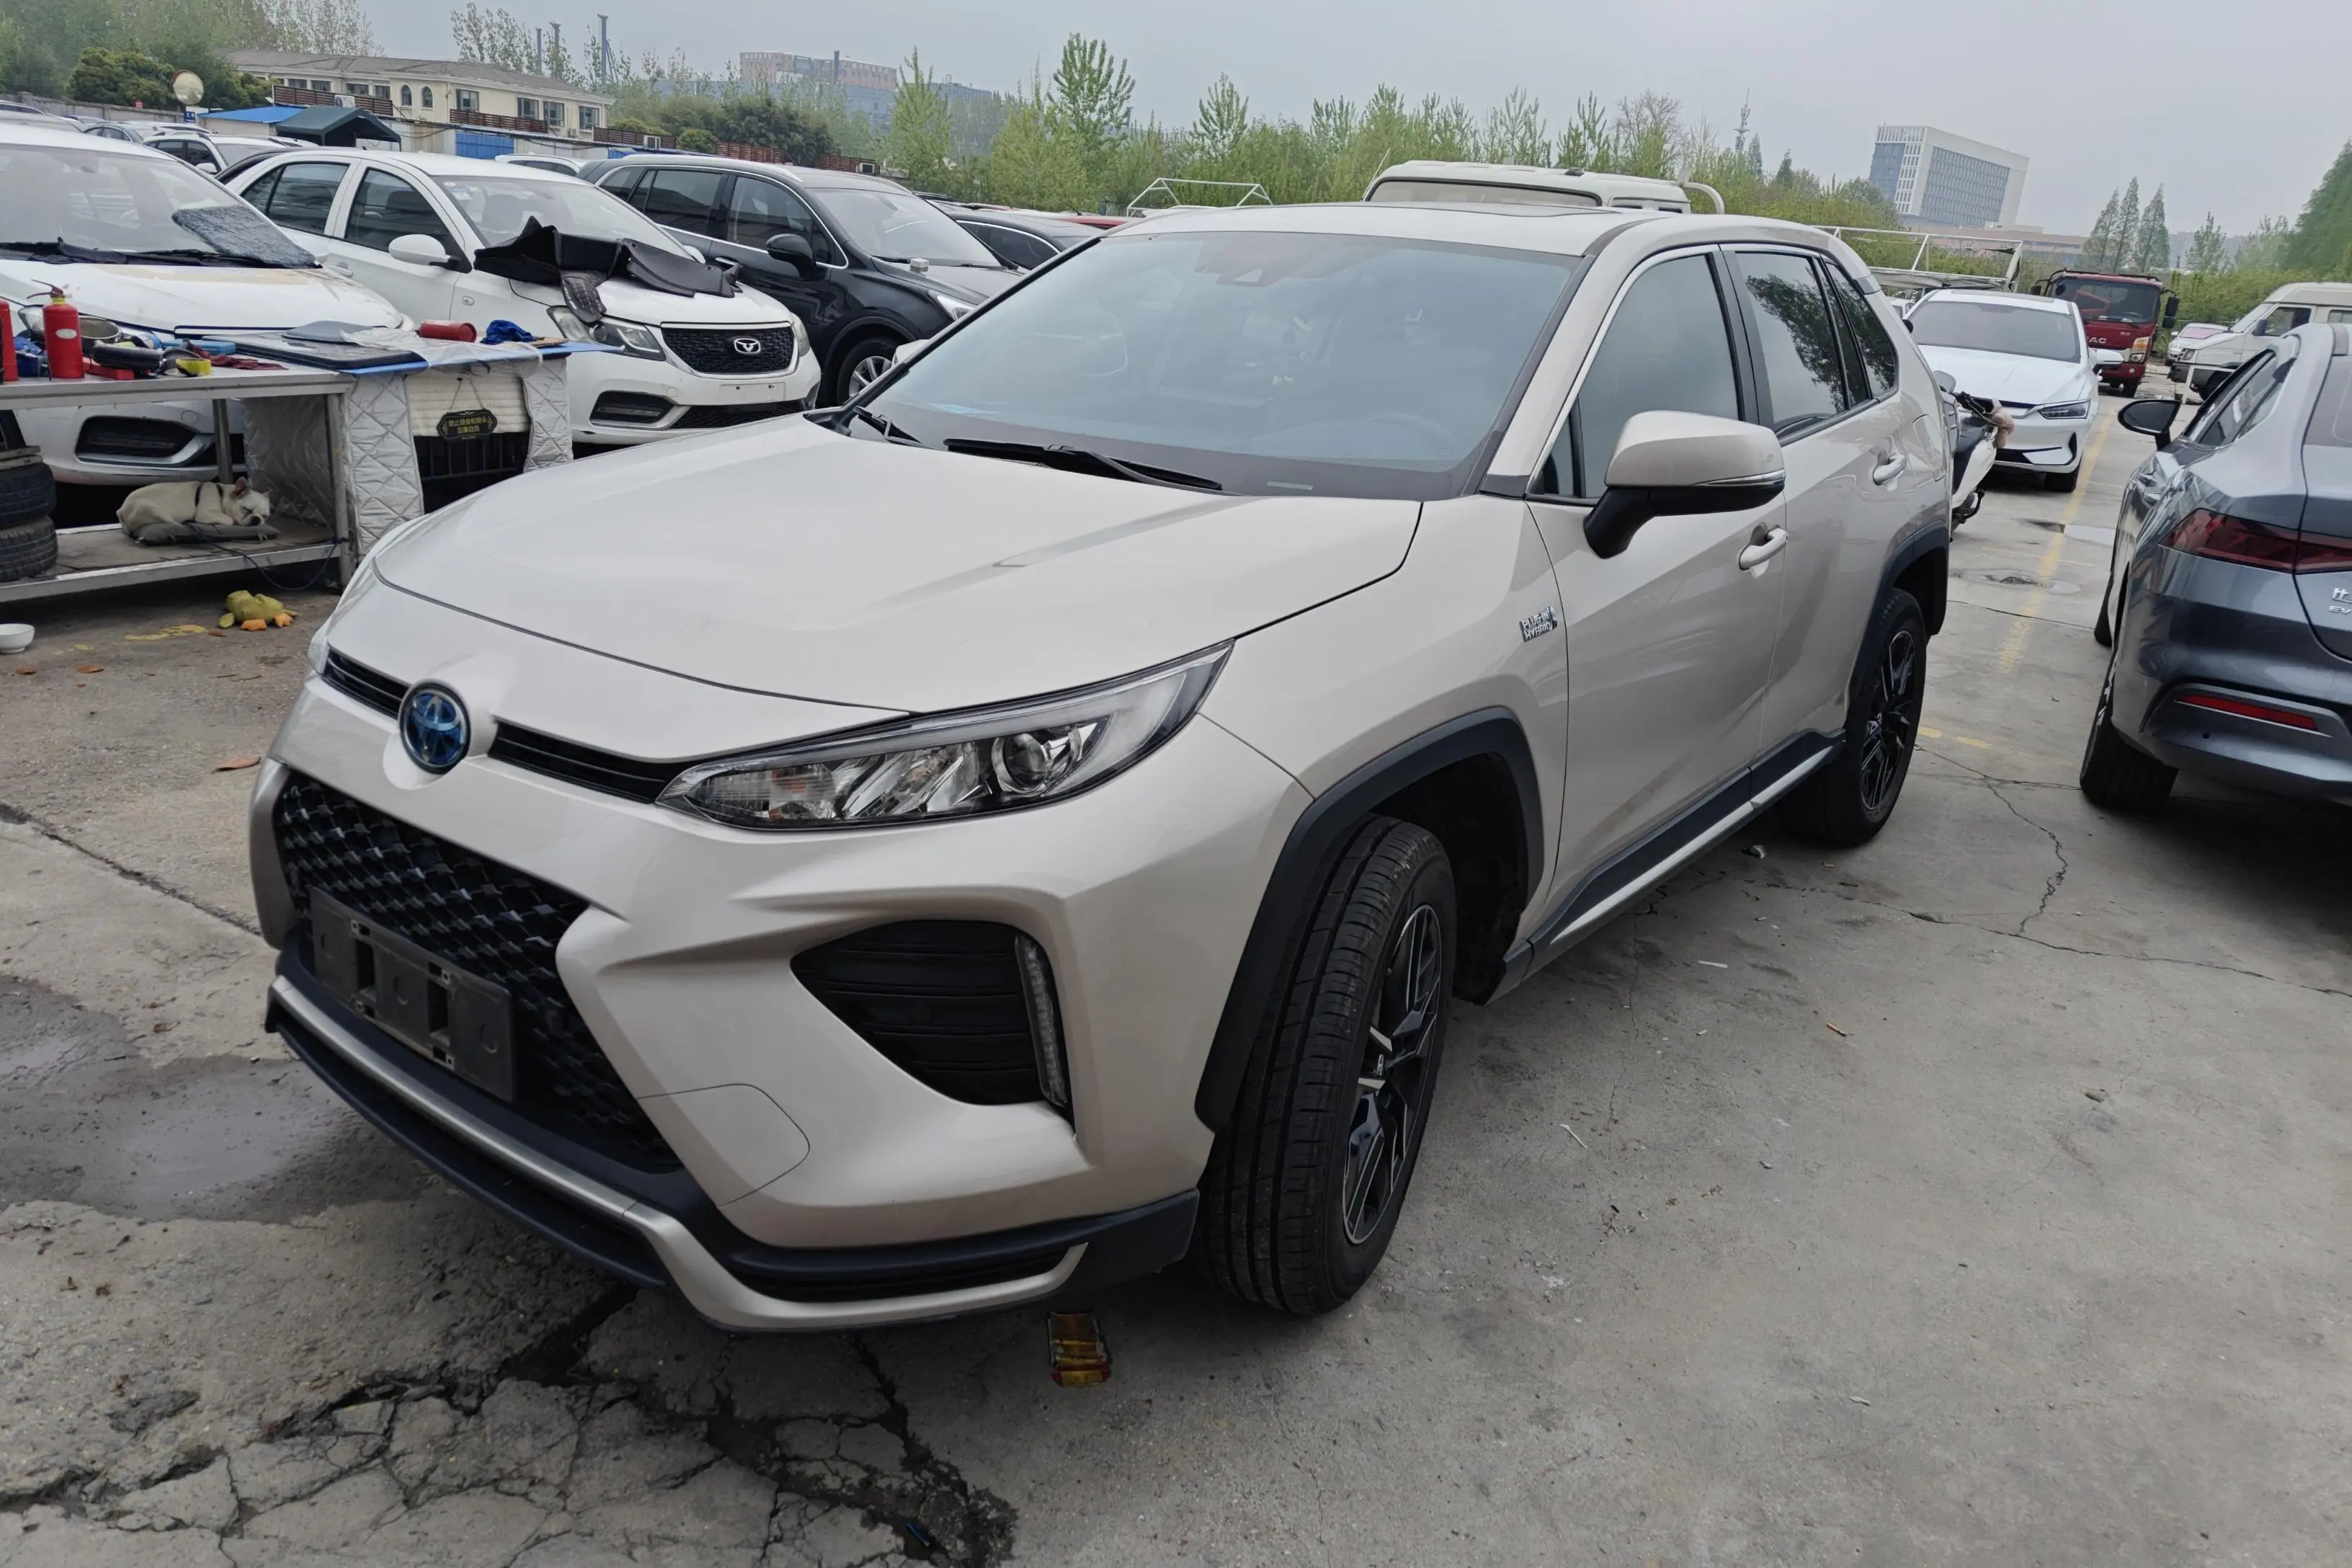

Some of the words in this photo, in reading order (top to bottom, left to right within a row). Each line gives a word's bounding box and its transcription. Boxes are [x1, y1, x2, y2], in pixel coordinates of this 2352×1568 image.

[2328, 605, 2352, 614] EV
[1522, 610, 1550, 630] PLUG-IN
[1523, 621, 1553, 640] HYBRID
